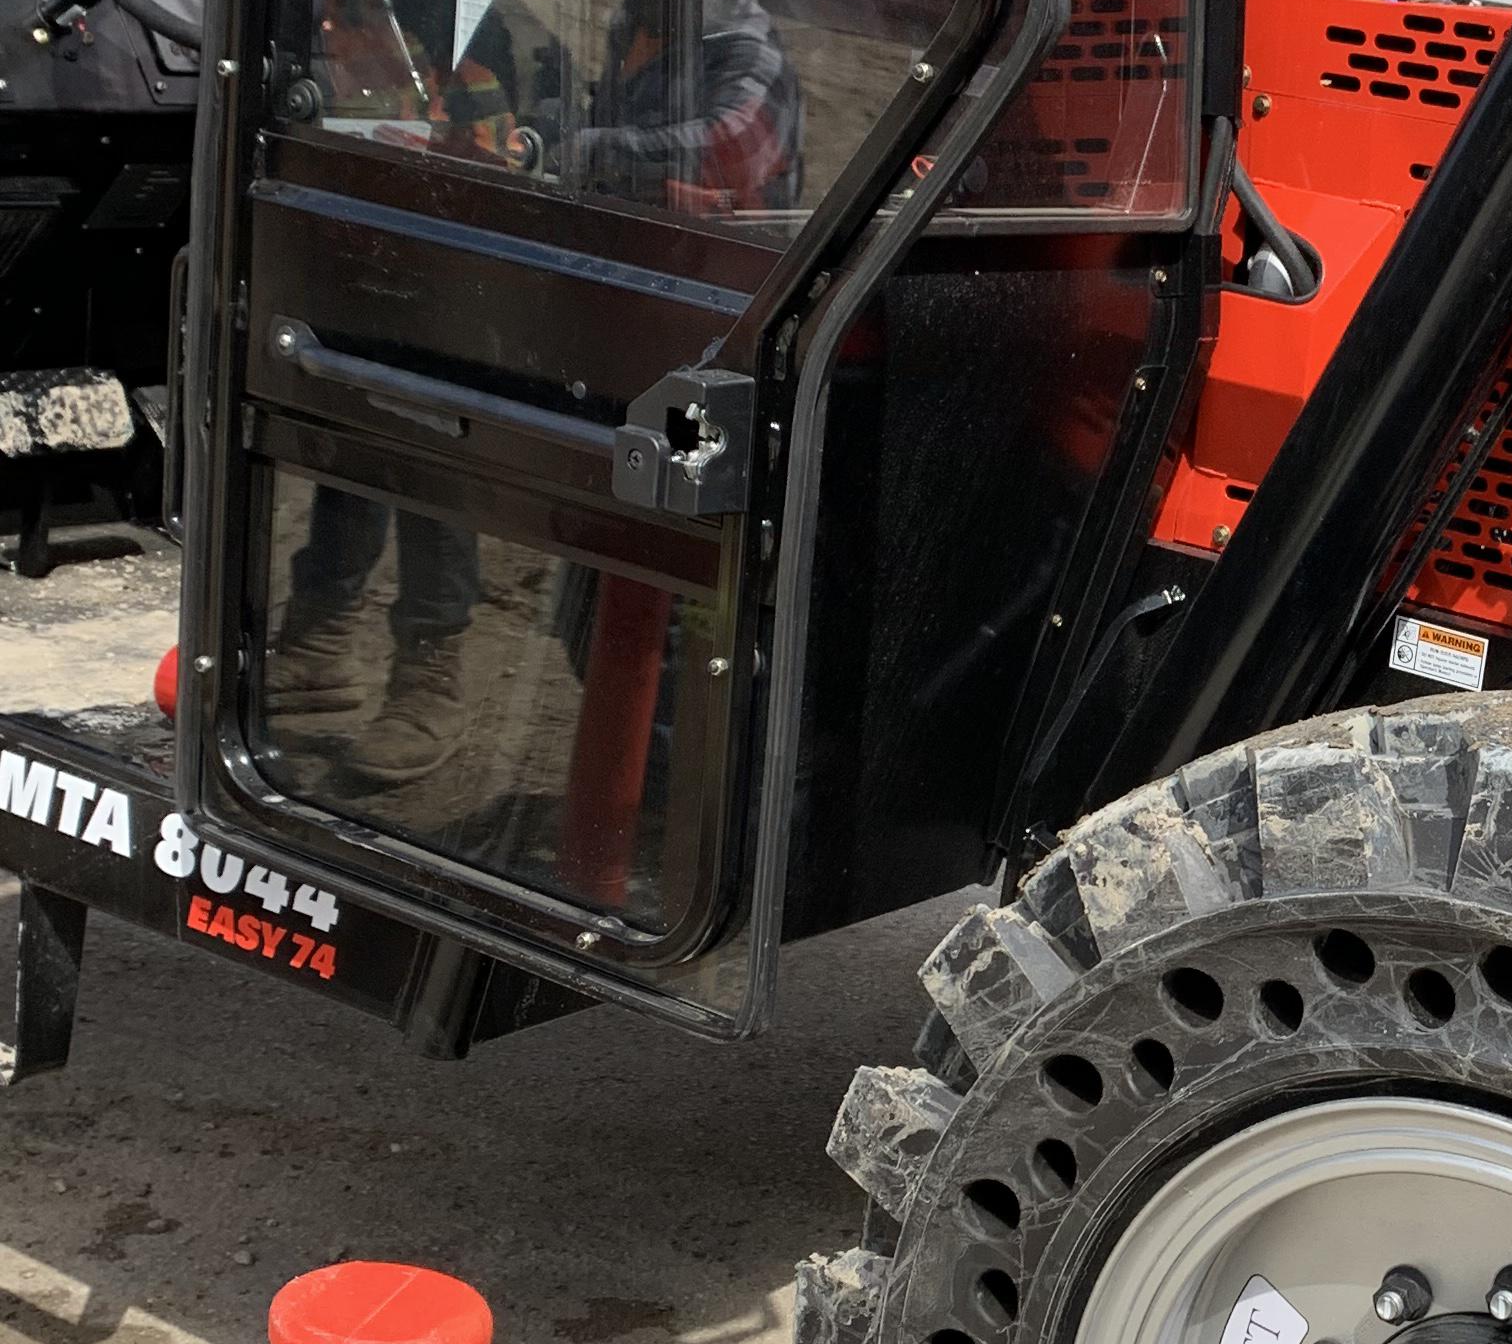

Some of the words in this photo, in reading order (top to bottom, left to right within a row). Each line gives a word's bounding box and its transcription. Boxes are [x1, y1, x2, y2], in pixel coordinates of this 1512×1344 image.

[1432, 631, 1481, 653] WARNING
[0, 749, 132, 859] MTA
[154, 812, 340, 933] 8044
[186, 895, 287, 959] EASY
[289, 932, 338, 980] 74
